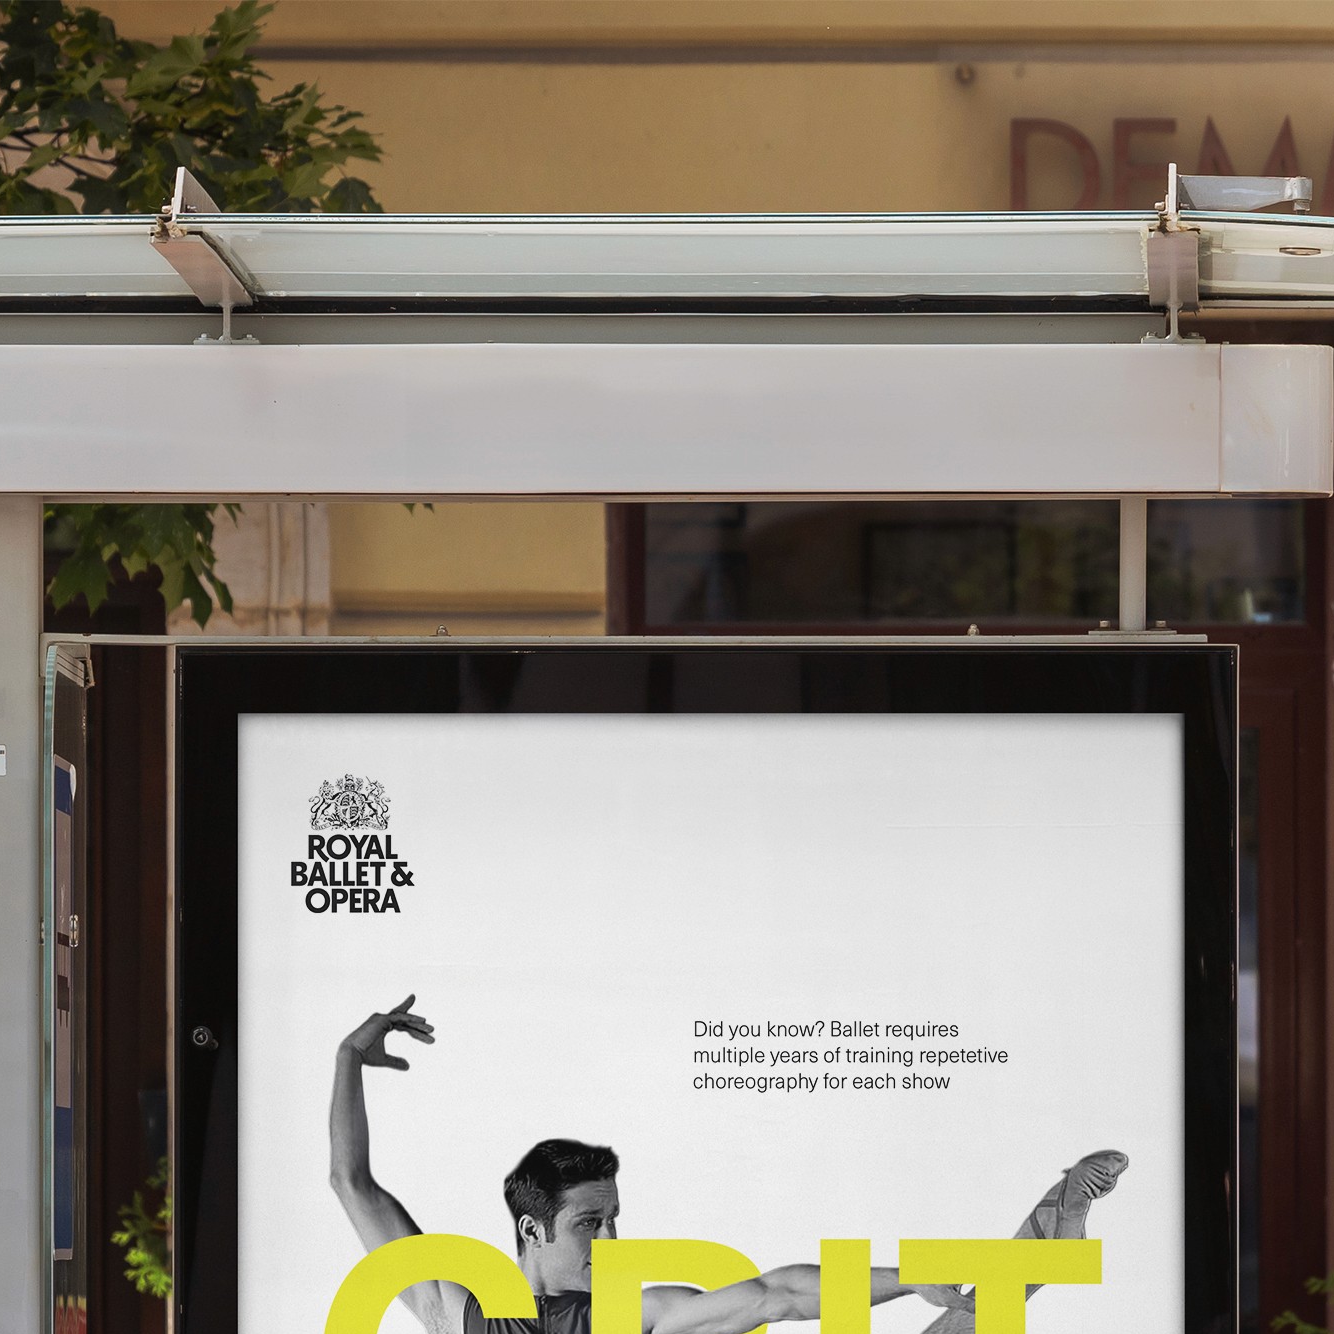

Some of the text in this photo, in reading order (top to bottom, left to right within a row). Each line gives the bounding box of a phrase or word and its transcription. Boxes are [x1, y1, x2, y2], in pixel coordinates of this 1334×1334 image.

[308, 833, 399, 862] ROYAL
[290, 861, 415, 887] BALLET &
[305, 887, 401, 914] OPERA
[694, 1020, 959, 1042] Did you know? Ballet requires
[693, 1046, 1009, 1068] multiple years of training repetetive
[693, 1072, 951, 1094] choreography for each show
